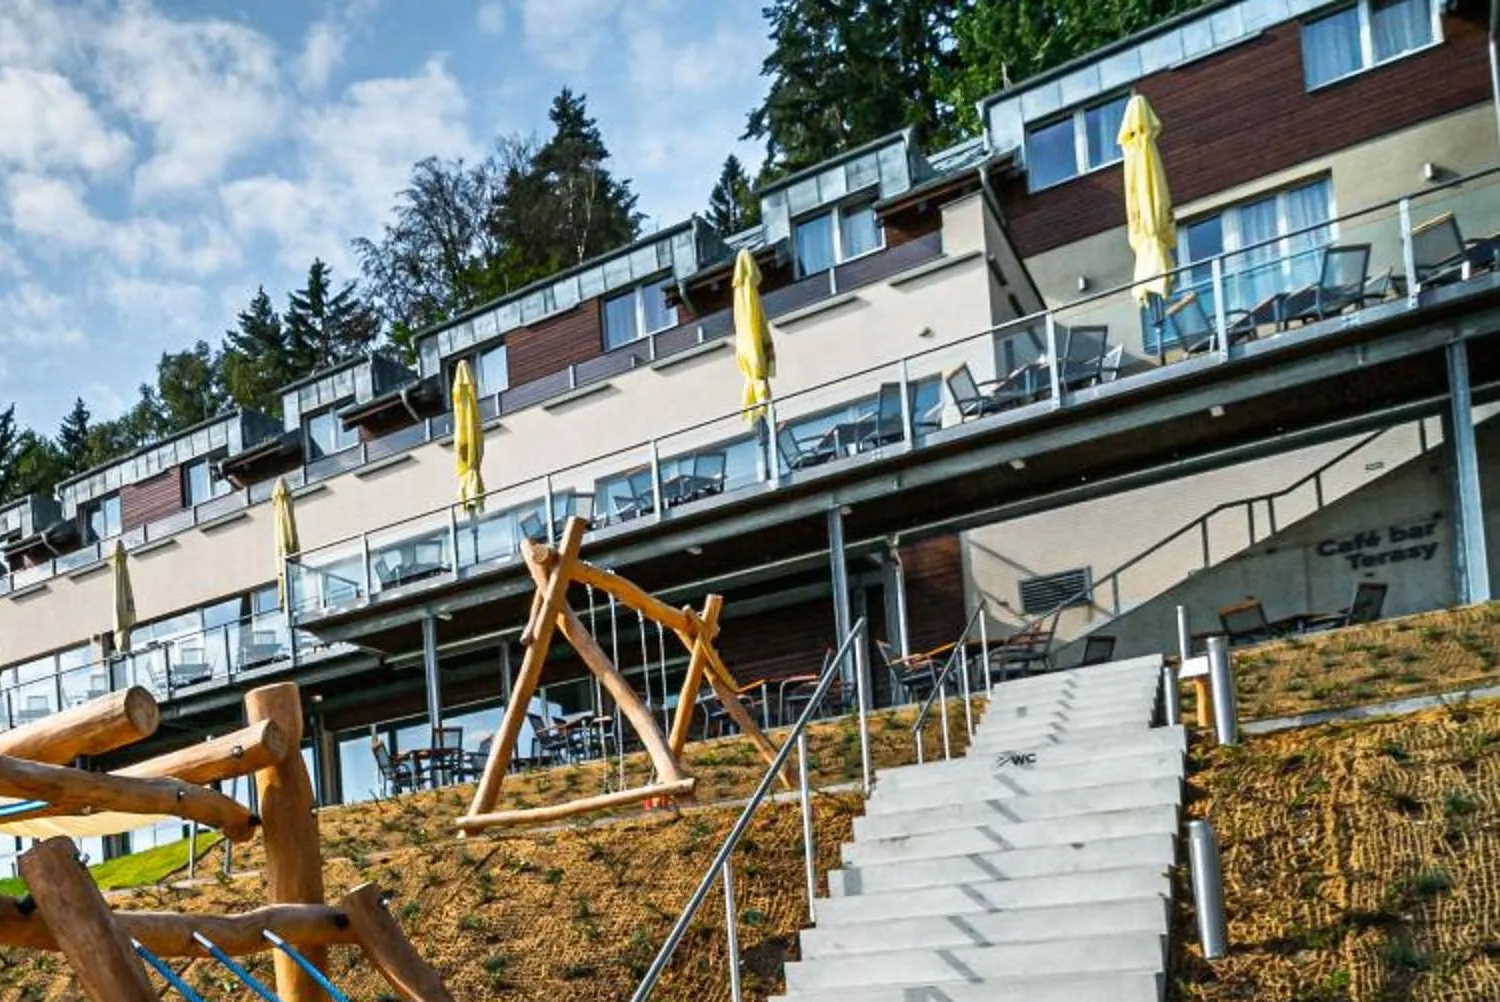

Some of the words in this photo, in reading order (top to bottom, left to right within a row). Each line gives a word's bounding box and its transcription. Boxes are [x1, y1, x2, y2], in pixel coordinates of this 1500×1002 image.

[1317, 530, 1381, 556] Café
[1389, 522, 1437, 543] bar
[1344, 541, 1439, 570] Terasy
[1011, 753, 1037, 766] WC
